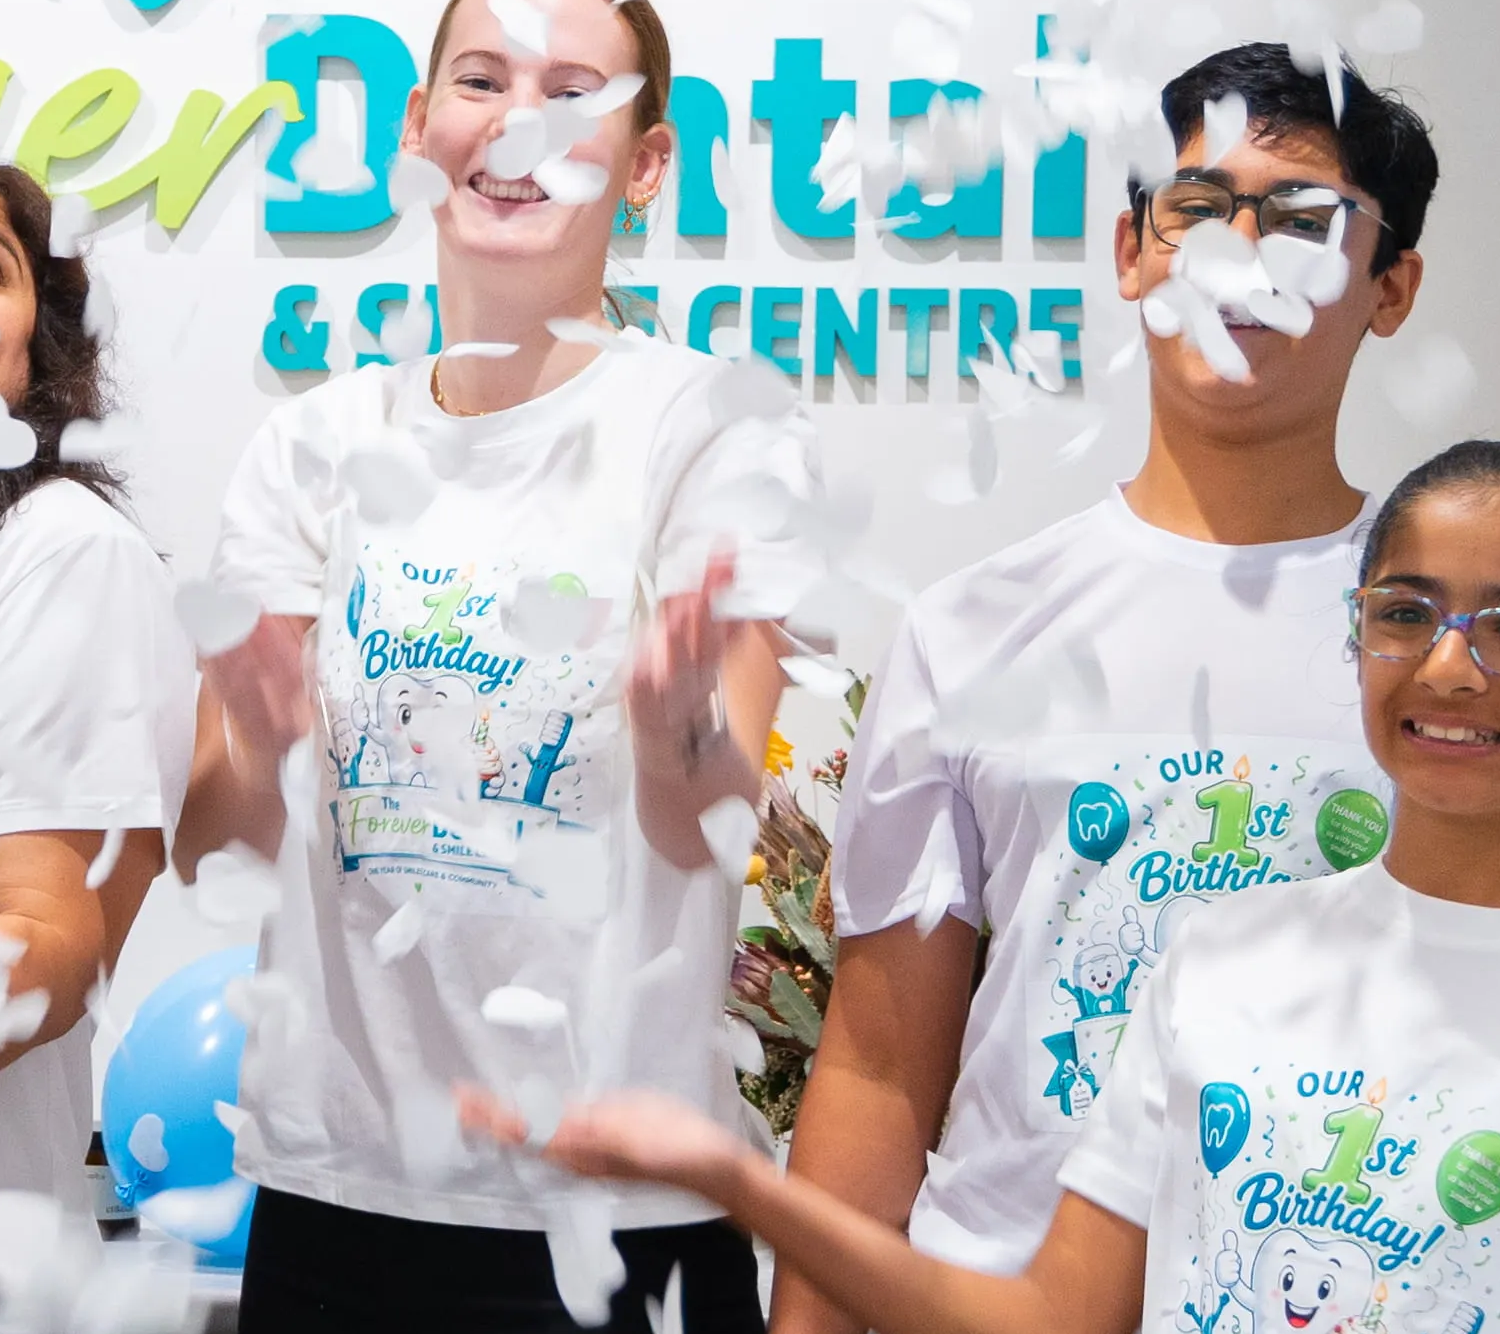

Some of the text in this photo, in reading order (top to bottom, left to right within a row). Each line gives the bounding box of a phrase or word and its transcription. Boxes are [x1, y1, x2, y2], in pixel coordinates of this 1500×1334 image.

[265, 13, 1087, 239] Dntal
[262, 283, 330, 372] &
[402, 562, 458, 585] OUR
[360, 629, 527, 695] Birthday!
[1159, 749, 1224, 783] OUR
[348, 794, 431, 847] Forever
[381, 796, 400, 811] The
[1192, 779, 1290, 867] 1st
[1331, 802, 1383, 835] THANK YOU
[1297, 1070, 1364, 1098] OUR
[1302, 1103, 1417, 1205] 1st
[1237, 1172, 1446, 1271] Birthday!
